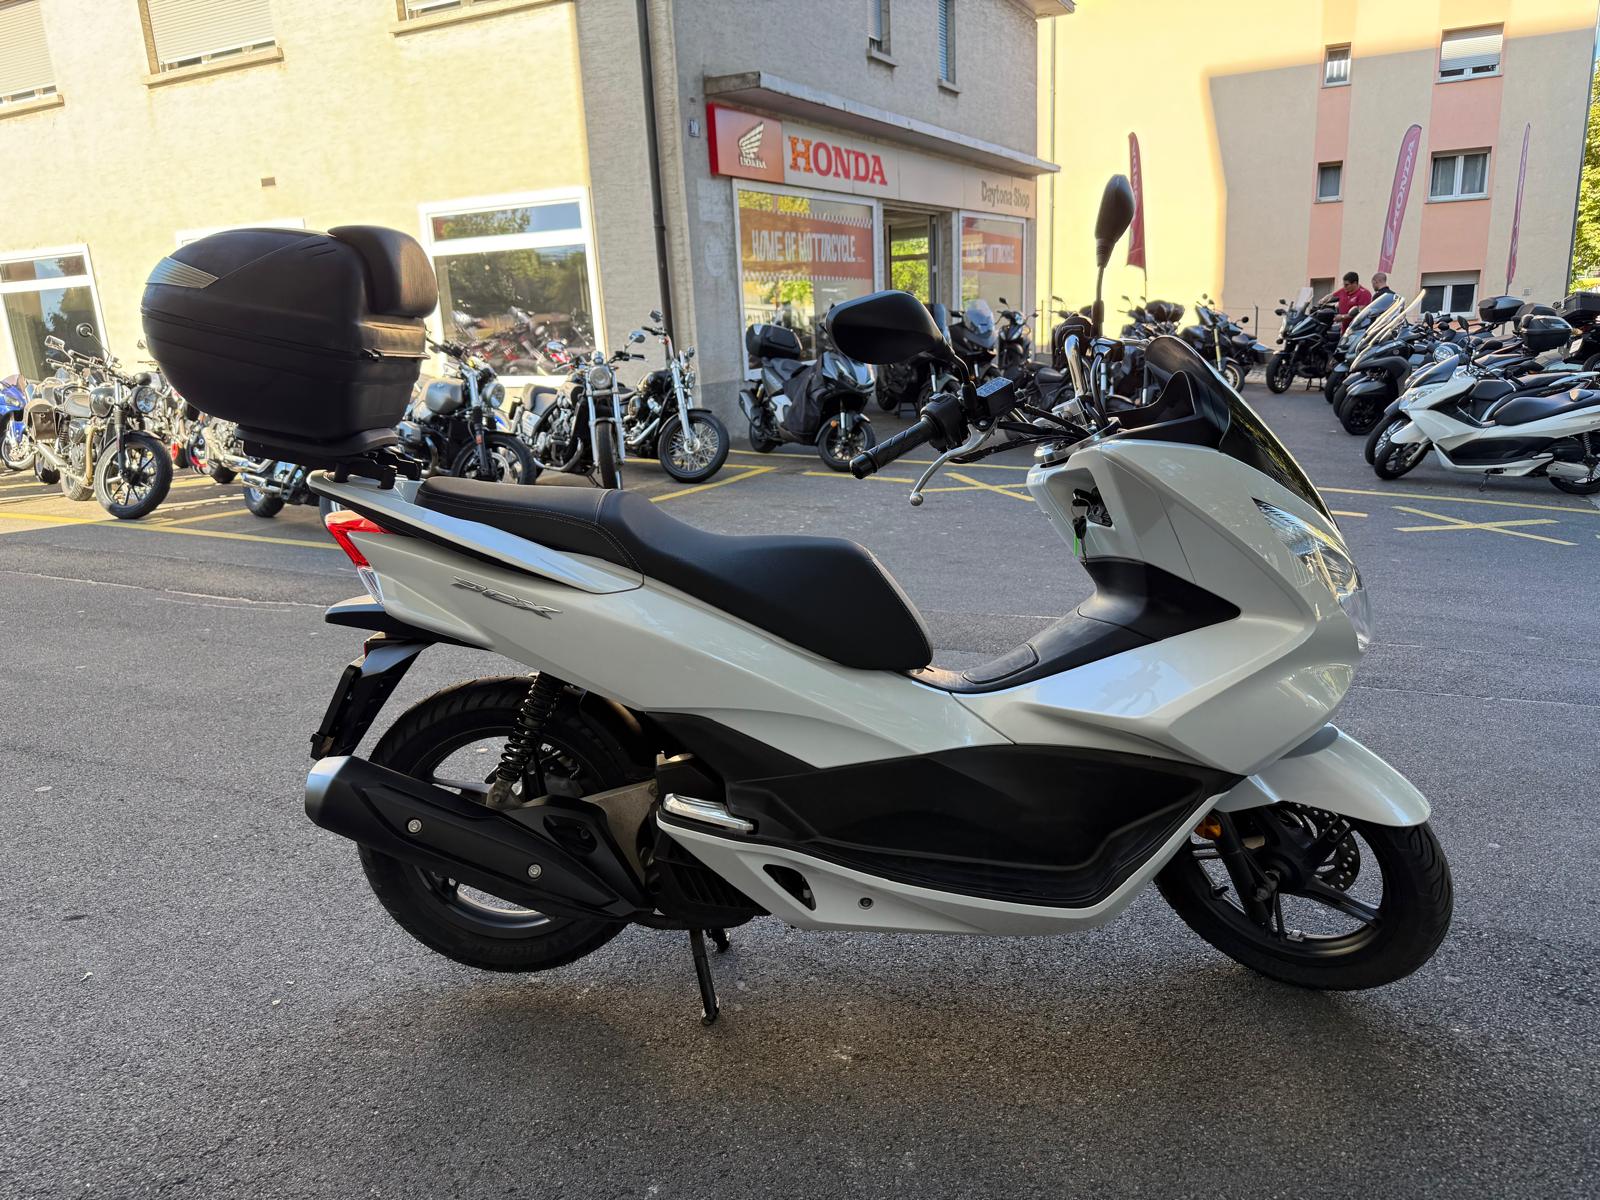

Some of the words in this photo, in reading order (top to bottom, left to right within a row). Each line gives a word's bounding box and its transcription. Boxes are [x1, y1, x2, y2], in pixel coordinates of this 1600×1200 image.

[788, 134, 888, 186] HONDA
[980, 180, 1012, 208] Daytona
[1013, 187, 1030, 212] Shop
[751, 229, 785, 262] HOME
[784, 231, 797, 262] OF
